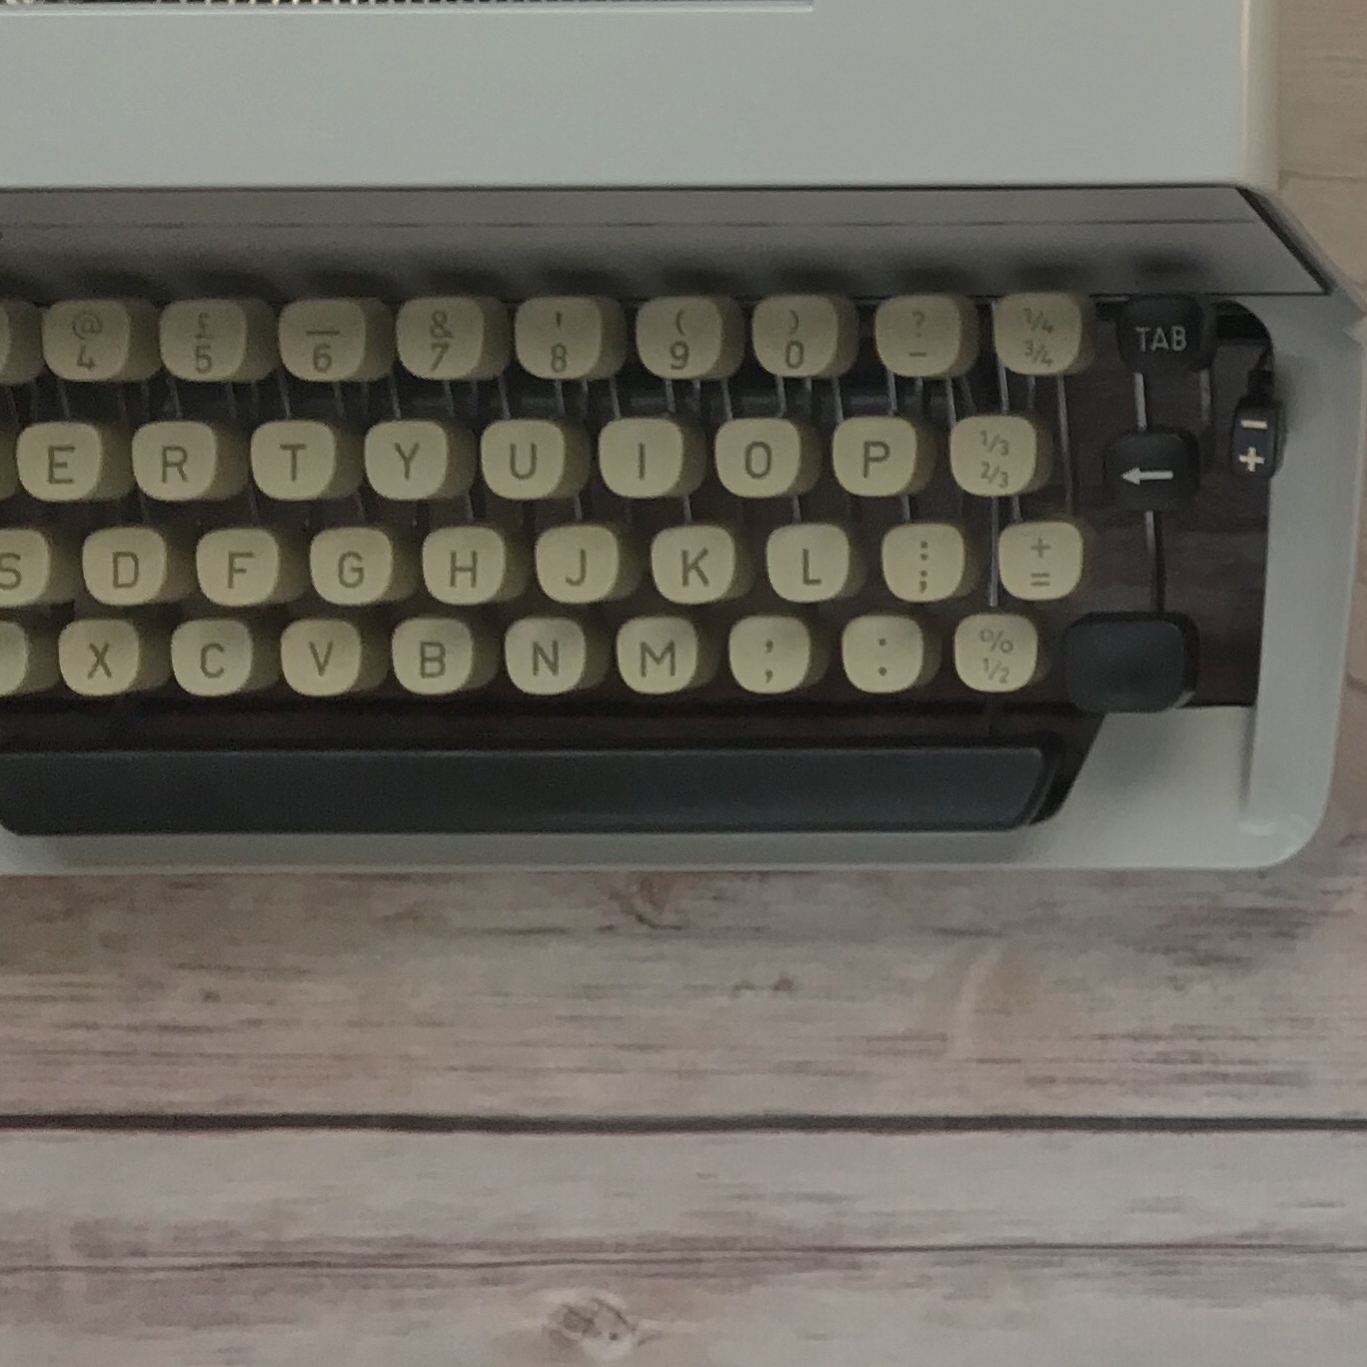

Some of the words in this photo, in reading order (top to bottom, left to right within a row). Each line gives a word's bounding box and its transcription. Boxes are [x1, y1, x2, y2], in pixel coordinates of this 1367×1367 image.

[430, 310, 455, 340] &
[1135, 325, 1188, 353] TAB
[76, 343, 97, 371] 4
[195, 343, 213, 374] 5
[312, 342, 333, 374] 6
[430, 342, 451, 372] 7
[551, 342, 568, 373] 8
[669, 340, 689, 370] 9
[47, 444, 76, 485] E
[161, 445, 189, 484] R
[279, 443, 307, 483] T
[393, 442, 421, 480] Y
[509, 442, 538, 480] U
[744, 441, 773, 480] O
[862, 440, 891, 479] P
[0, 552, 22, 591] S
[111, 551, 140, 589] D
[227, 551, 255, 590] F
[337, 550, 366, 589] G
[449, 550, 478, 589] H
[564, 548, 588, 588] J
[681, 547, 710, 588] K
[801, 548, 822, 586] L
[86, 641, 113, 680] X
[199, 642, 225, 680] C
[308, 640, 334, 678] V
[419, 640, 447, 679] B
[531, 639, 559, 677] N
[639, 640, 677, 678] M
